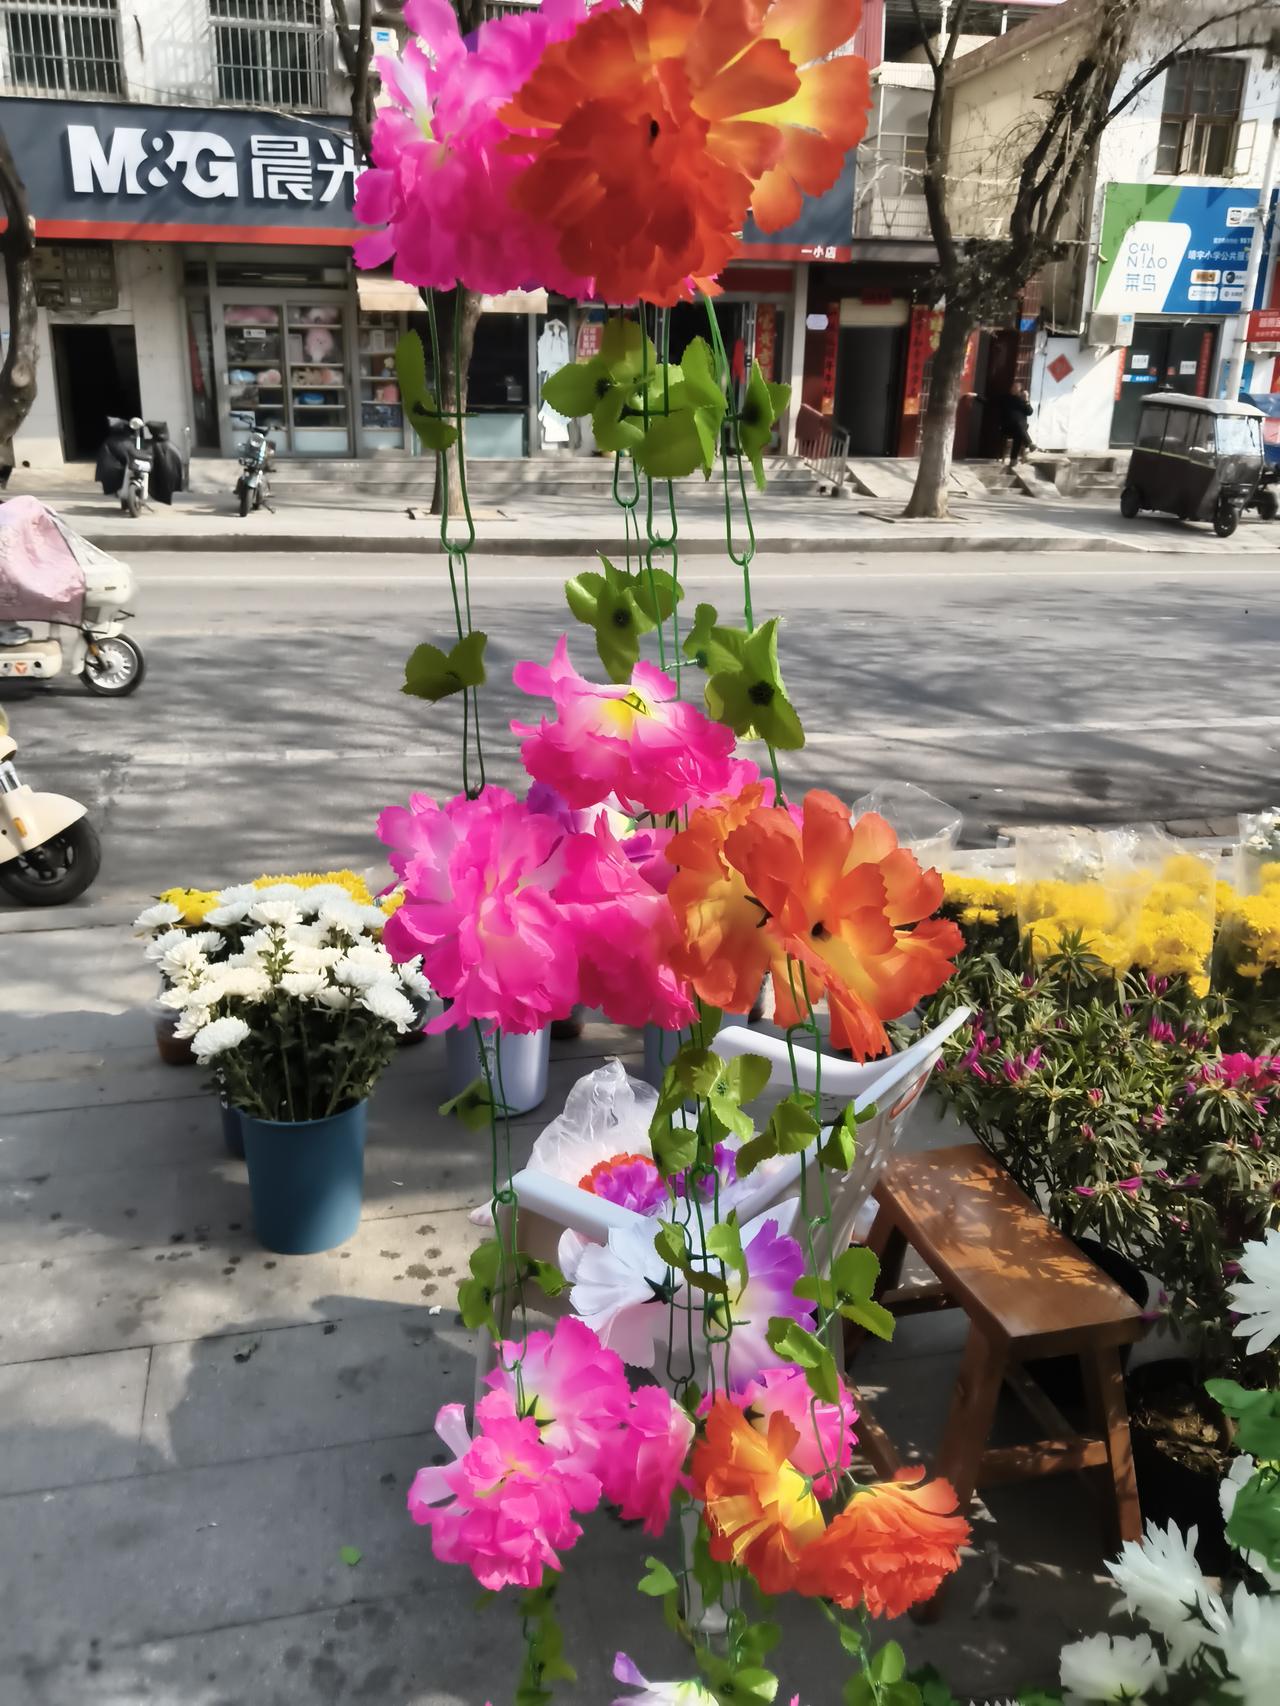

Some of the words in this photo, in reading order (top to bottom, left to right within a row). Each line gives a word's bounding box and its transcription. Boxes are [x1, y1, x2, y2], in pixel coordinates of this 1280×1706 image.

[67, 125, 239, 199] M&G
[800, 245, 837, 260] 一小店
[1125, 273, 1156, 292] 菜鸟
